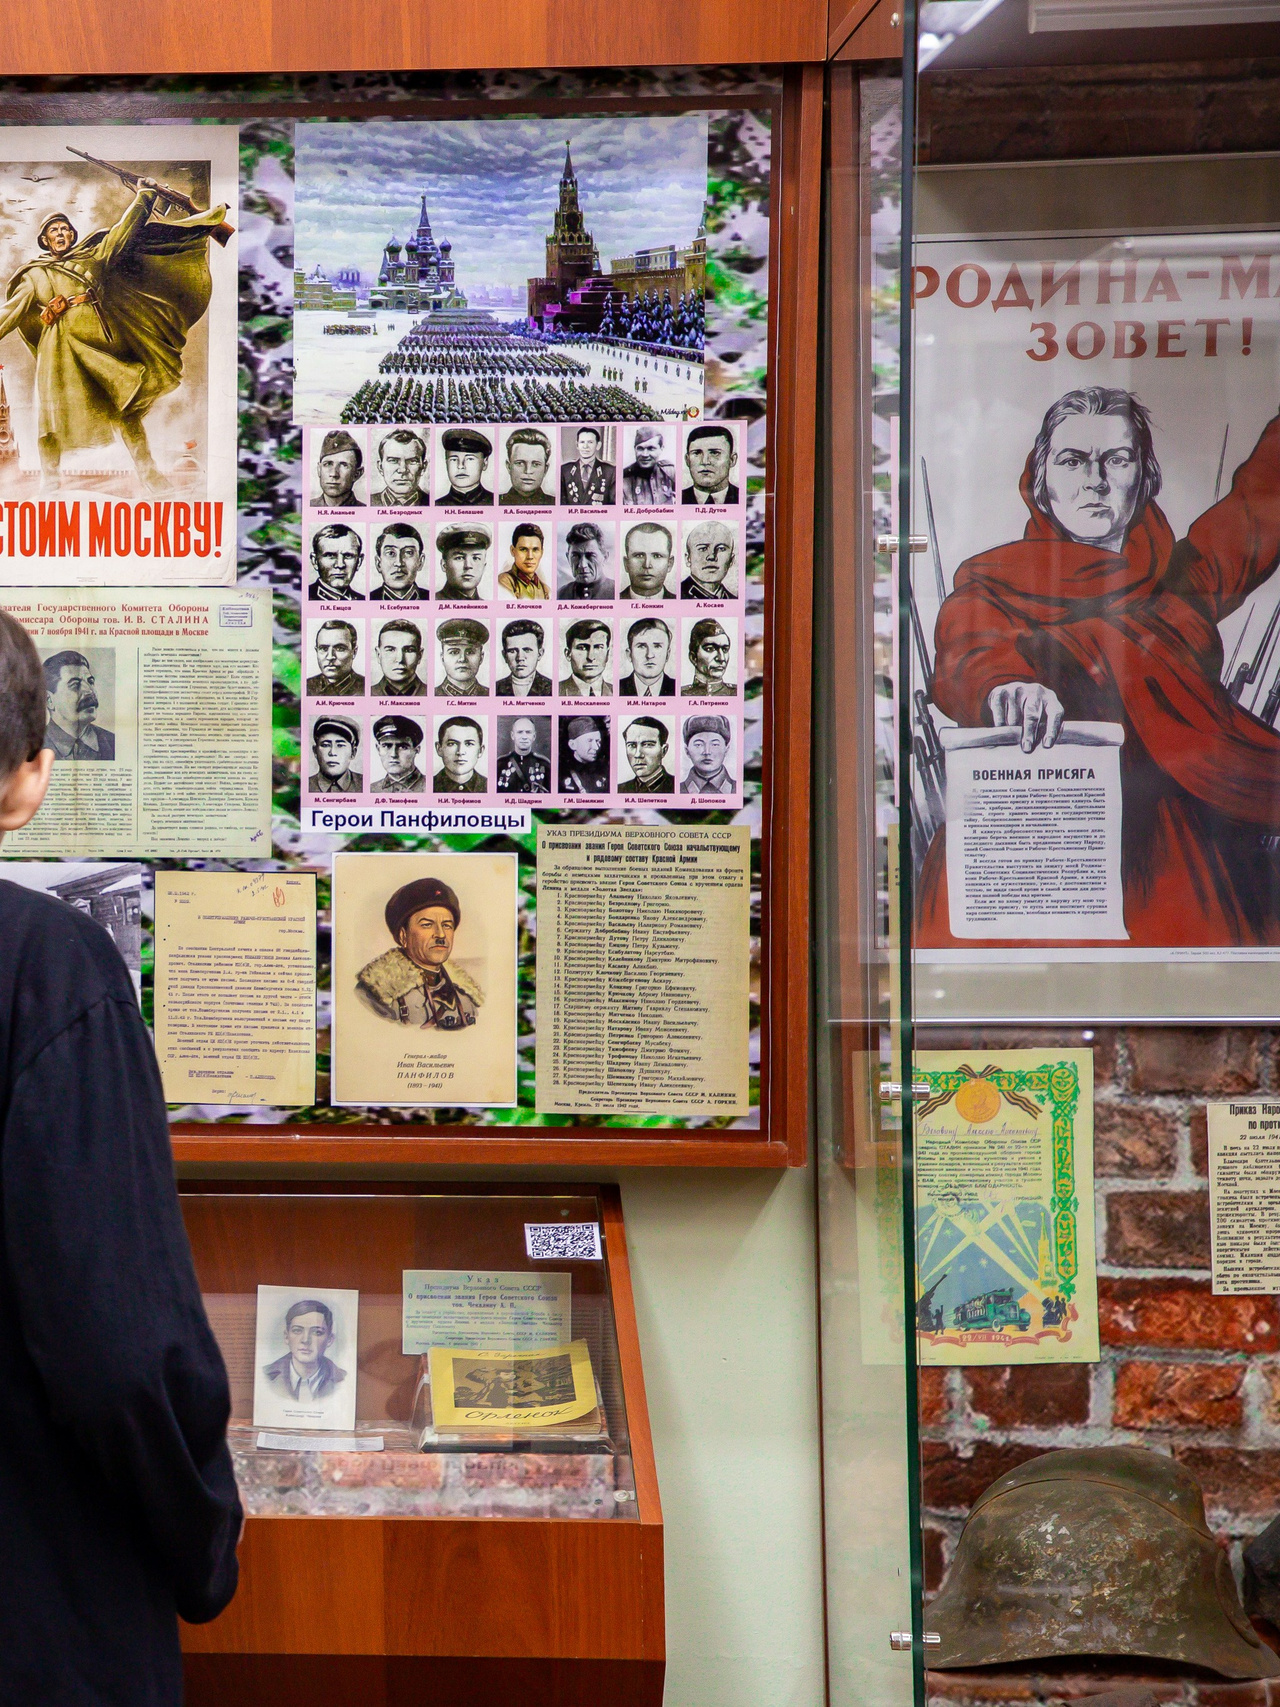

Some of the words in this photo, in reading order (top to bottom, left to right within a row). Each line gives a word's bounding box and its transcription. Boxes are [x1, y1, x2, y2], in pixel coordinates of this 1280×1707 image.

[911, 253, 1280, 313] РОДИНА-М
[1026, 316, 1253, 361] ЗОВЕТ!
[89, 502, 223, 558] МОСКВУ!
[36, 603, 116, 614] Государственного
[121, 603, 162, 612] Комитета
[168, 604, 209, 614] Обороны
[59, 615, 100, 625] Обороны
[123, 615, 133, 624] И.
[136, 615, 145, 624] В.
[151, 614, 208, 624] СТАЛИНА
[74, 628, 90, 636] 1941
[109, 628, 140, 636] Красной
[973, 770, 1031, 780] ВОЕННАЯ
[1038, 768, 1095, 780] ПРИСЯГА
[312, 810, 376, 831] Герои
[381, 810, 524, 832] Панфиловцы
[570, 830, 622, 838] ПРЕЗИДИУМА
[549, 842, 581, 850] присвоении
[608, 842, 624, 852] Героя
[628, 842, 660, 851] Советского
[664, 843, 682, 851] Союза
[686, 844, 740, 854] начальствующему
[594, 855, 622, 864] рядовому
[626, 856, 648, 864] составу
[652, 855, 676, 864] Красной
[679, 855, 697, 864] Армии
[1230, 1104, 1256, 1116] Приказ
[1262, 1104, 1280, 1116] Наро
